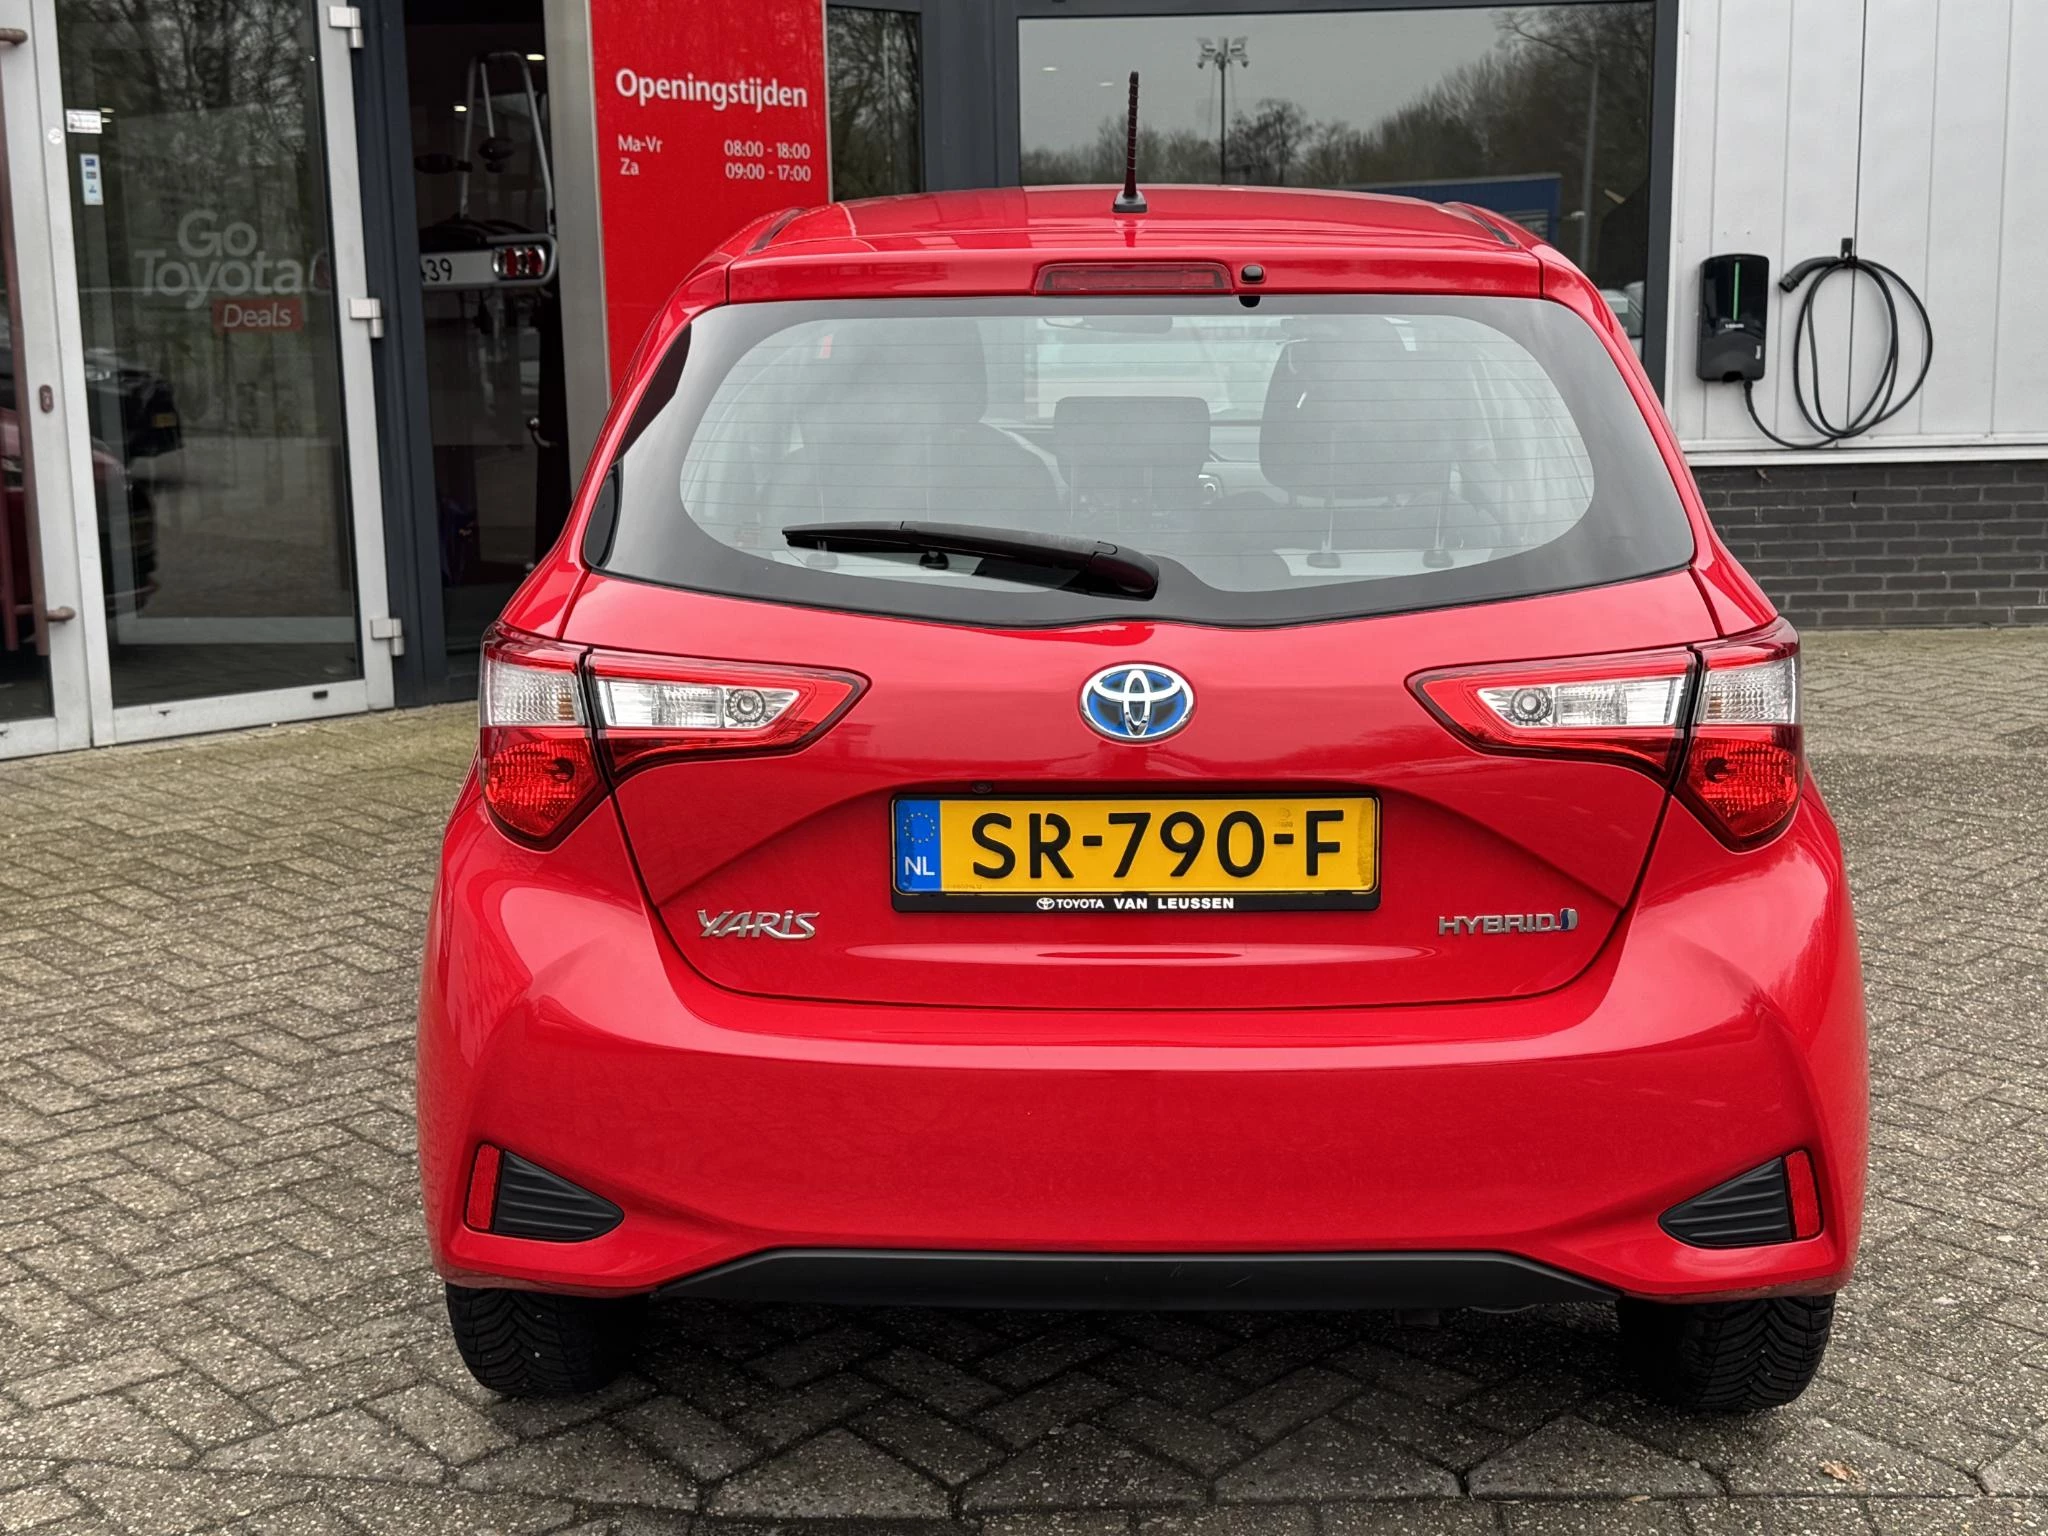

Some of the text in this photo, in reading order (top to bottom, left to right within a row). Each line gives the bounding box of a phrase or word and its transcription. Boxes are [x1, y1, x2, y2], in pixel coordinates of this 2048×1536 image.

[615, 68, 808, 113] Openingstijden
[617, 134, 662, 153] Ma-Vr
[724, 140, 764, 157] 08:00
[777, 142, 811, 159] 18:00
[620, 157, 640, 176] Za
[725, 162, 765, 180] 09:00
[777, 165, 812, 182] 17:00
[177, 209, 257, 257] Go
[134, 250, 303, 309] Toyota
[223, 302, 292, 328] Deals
[971, 809, 1344, 879] SR-790-F
[905, 856, 935, 876] NL
[1056, 897, 1234, 909] TOYOTA VAN LEUSSEN
[1438, 913, 1560, 935] HYBRID
